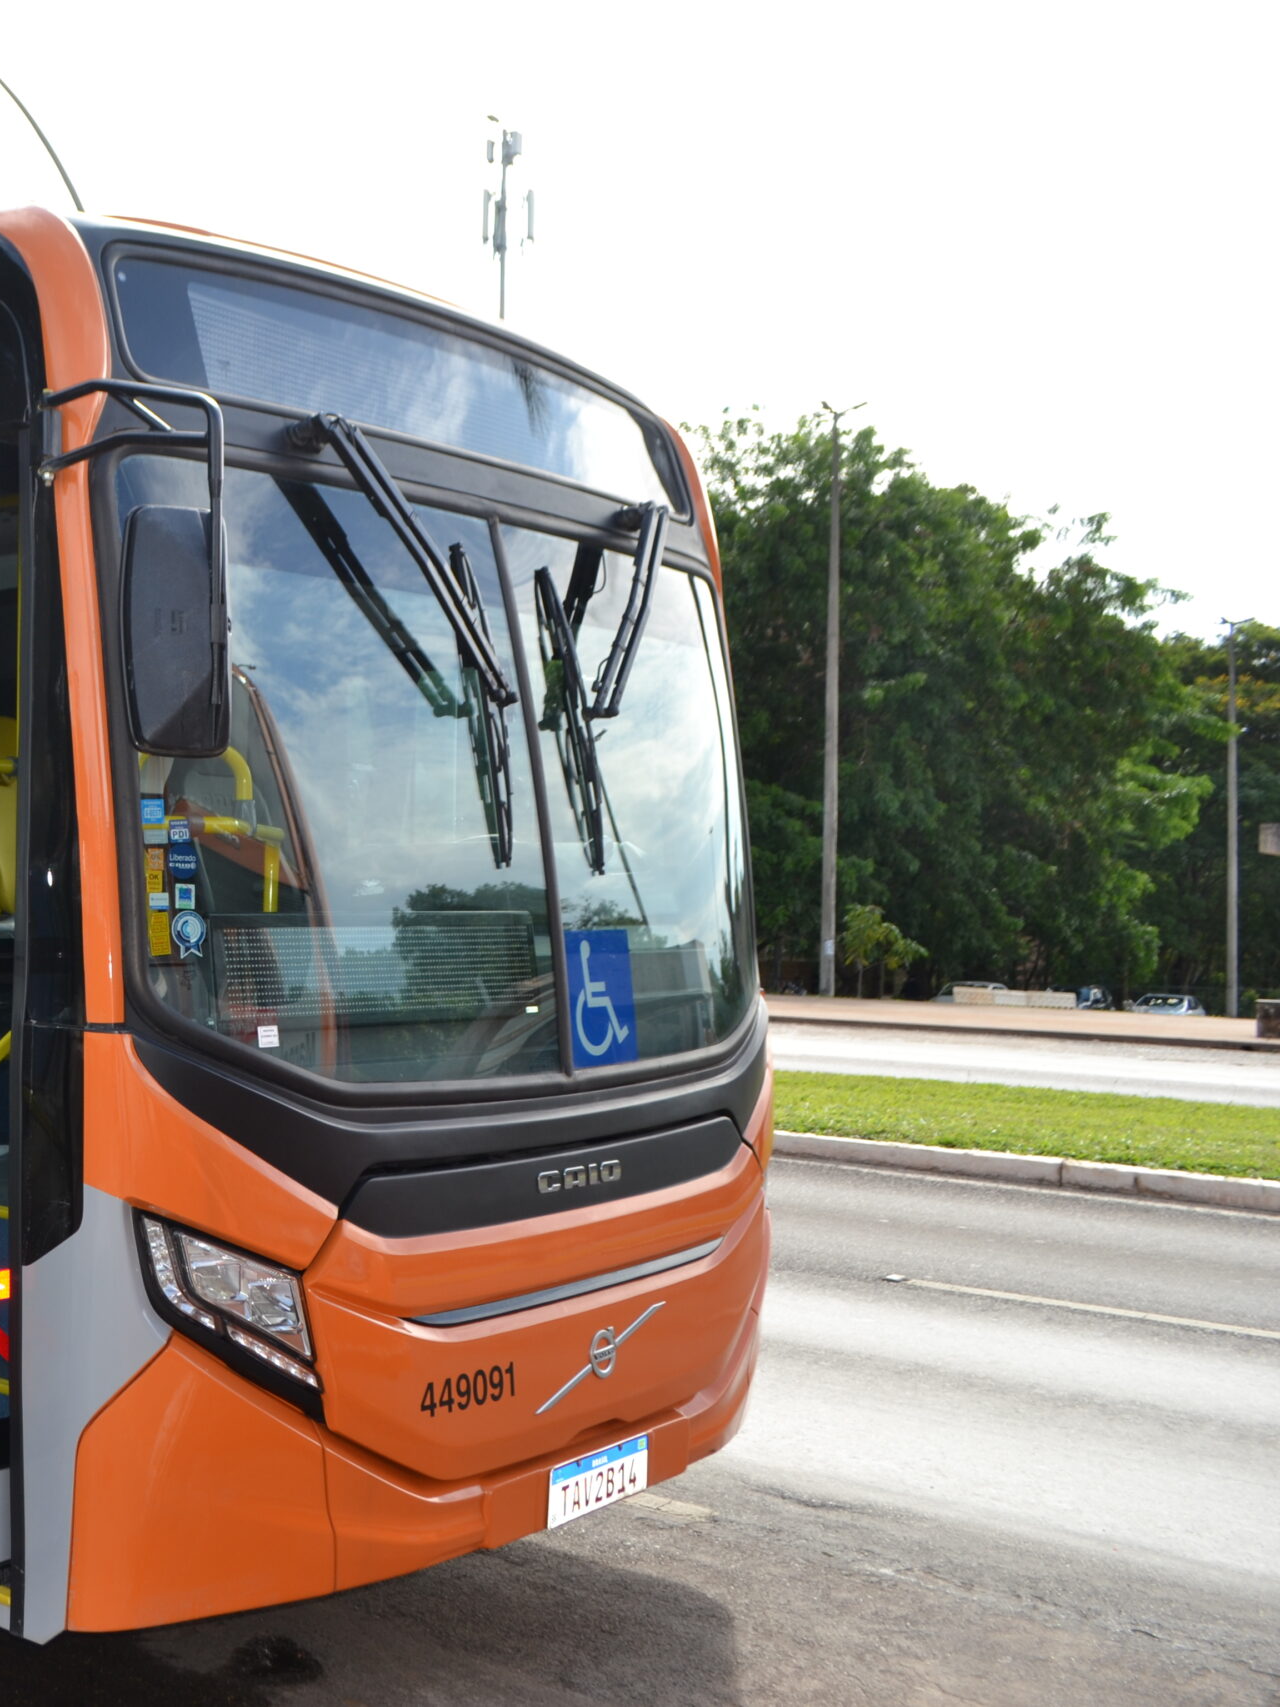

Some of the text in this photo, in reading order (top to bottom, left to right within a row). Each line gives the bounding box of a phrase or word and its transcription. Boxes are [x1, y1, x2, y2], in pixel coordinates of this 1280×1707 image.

[172, 830, 188, 839] PDI
[169, 853, 197, 862] Liberado
[149, 873, 160, 881] OK
[537, 1160, 622, 1194] CAIO
[420, 1361, 516, 1418] 449091
[561, 1458, 637, 1517] TAV2B14
